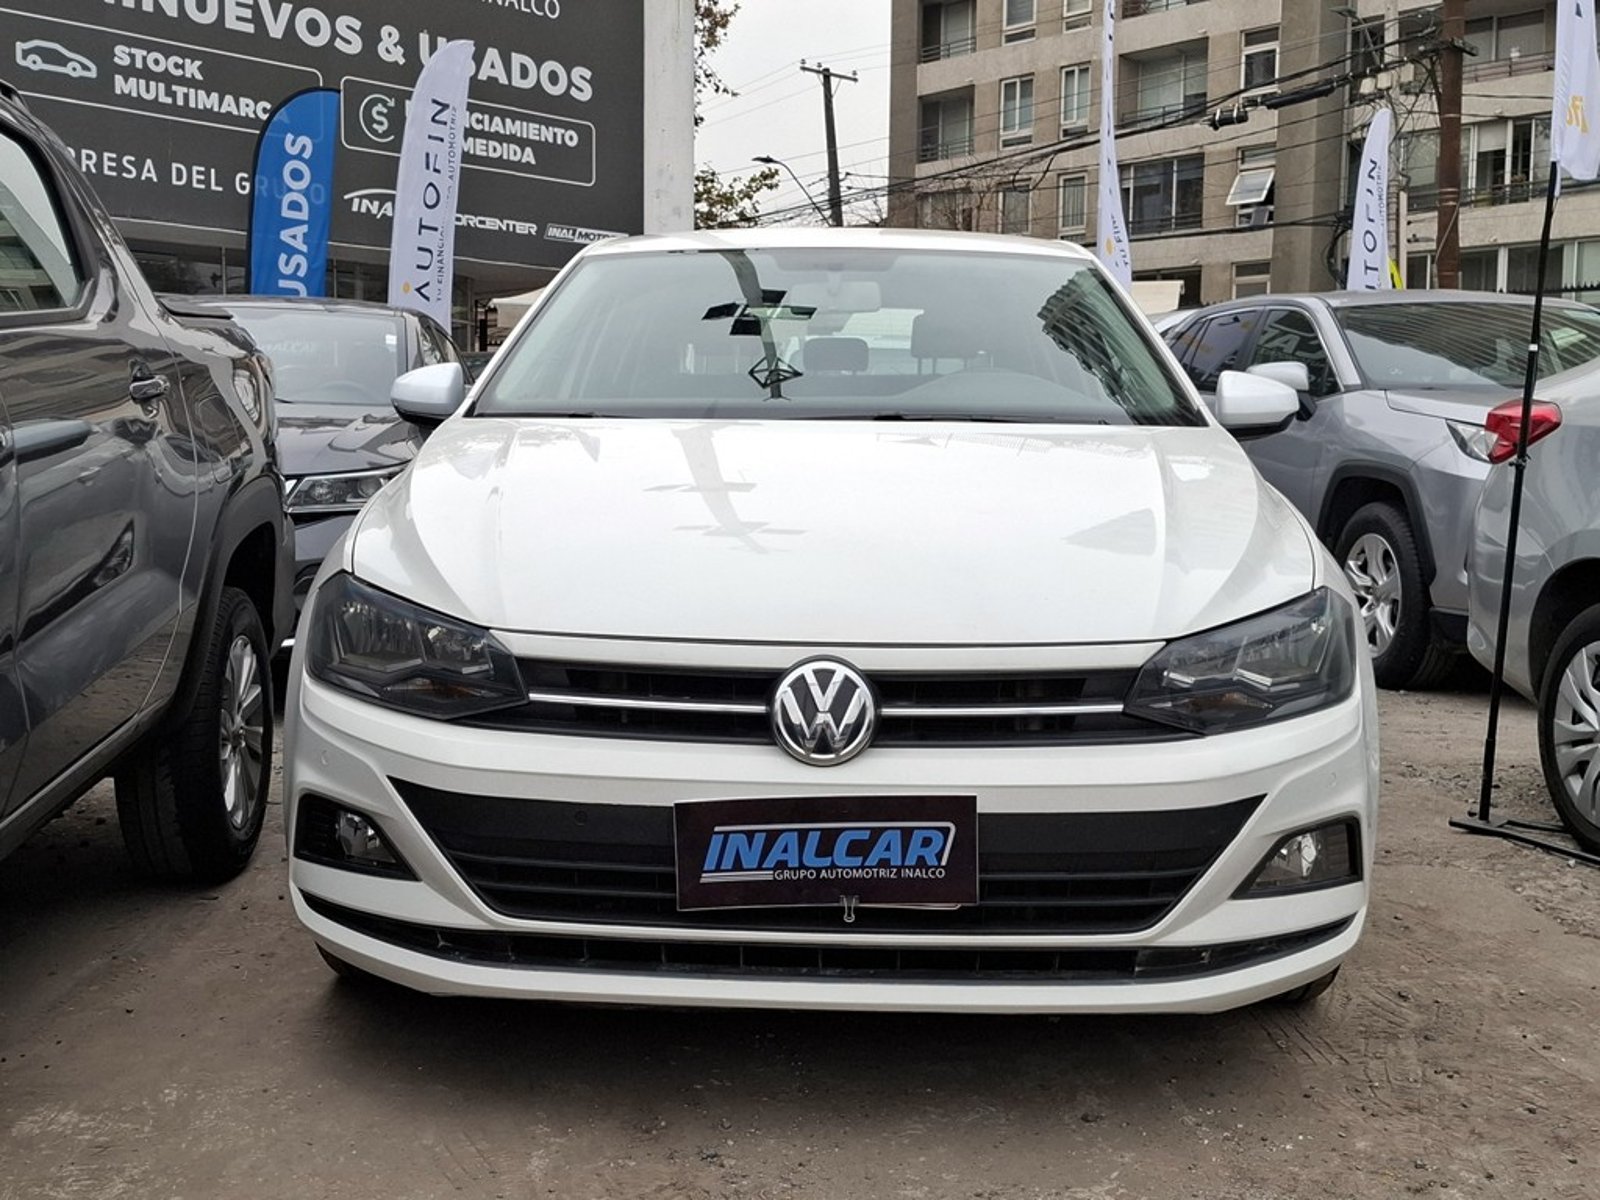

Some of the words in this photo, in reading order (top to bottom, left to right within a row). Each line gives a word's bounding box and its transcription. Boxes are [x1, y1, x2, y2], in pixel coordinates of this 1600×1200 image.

[113, 45, 204, 80] STOCK
[378, 25, 406, 65] &
[419, 29, 593, 102] UADOS
[171, 162, 223, 191] DEL
[414, 98, 450, 302] AUTOFIN
[702, 829, 945, 871] INALCAR
[774, 868, 817, 881] GRUPO
[819, 867, 898, 880] AUTOMOTRIZ
[900, 867, 946, 879] INALCO
